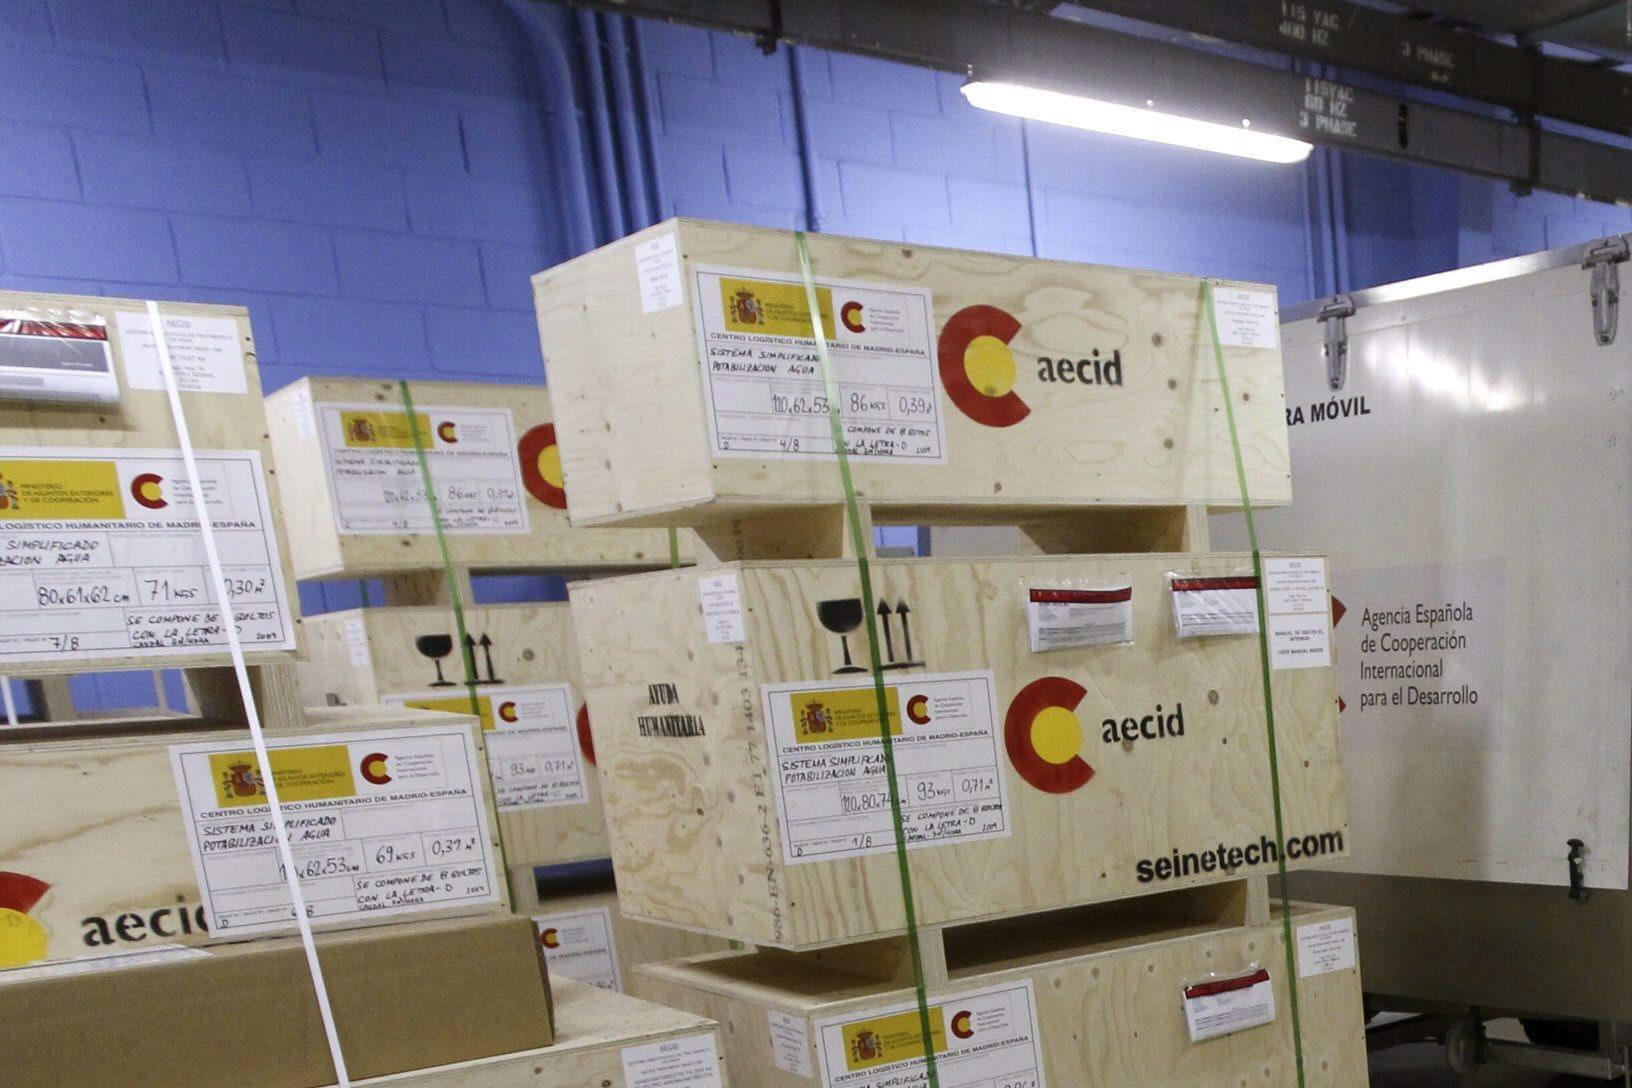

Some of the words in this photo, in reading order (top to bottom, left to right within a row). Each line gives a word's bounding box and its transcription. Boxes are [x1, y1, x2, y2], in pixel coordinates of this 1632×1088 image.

[710, 332, 746, 342] CENTRO
[1037, 348, 1124, 388] aecid
[1311, 396, 1371, 423] MÓVIL
[65, 522, 144, 530] HUMANITARIO
[7, 539, 100, 550] SIMPLIFICADO
[1361, 607, 1411, 634] Agencia
[1416, 602, 1473, 629] Española
[1361, 634, 1376, 653] de
[1380, 632, 1466, 656] Cooperación
[1360, 659, 1443, 681] Internacional
[1360, 692, 1388, 711] para
[1391, 687, 1403, 706] el
[1407, 686, 1478, 706] Desarrollo
[1101, 702, 1186, 744] aecid
[782, 744, 816, 754] CENTRO
[781, 757, 827, 771] SISTEMA
[200, 808, 245, 819] CENTRO
[304, 797, 372, 811] HUMANITARIO
[374, 795, 388, 803] DE
[203, 823, 256, 836] SISTEMA
[1135, 829, 1344, 883] seinetech.com
